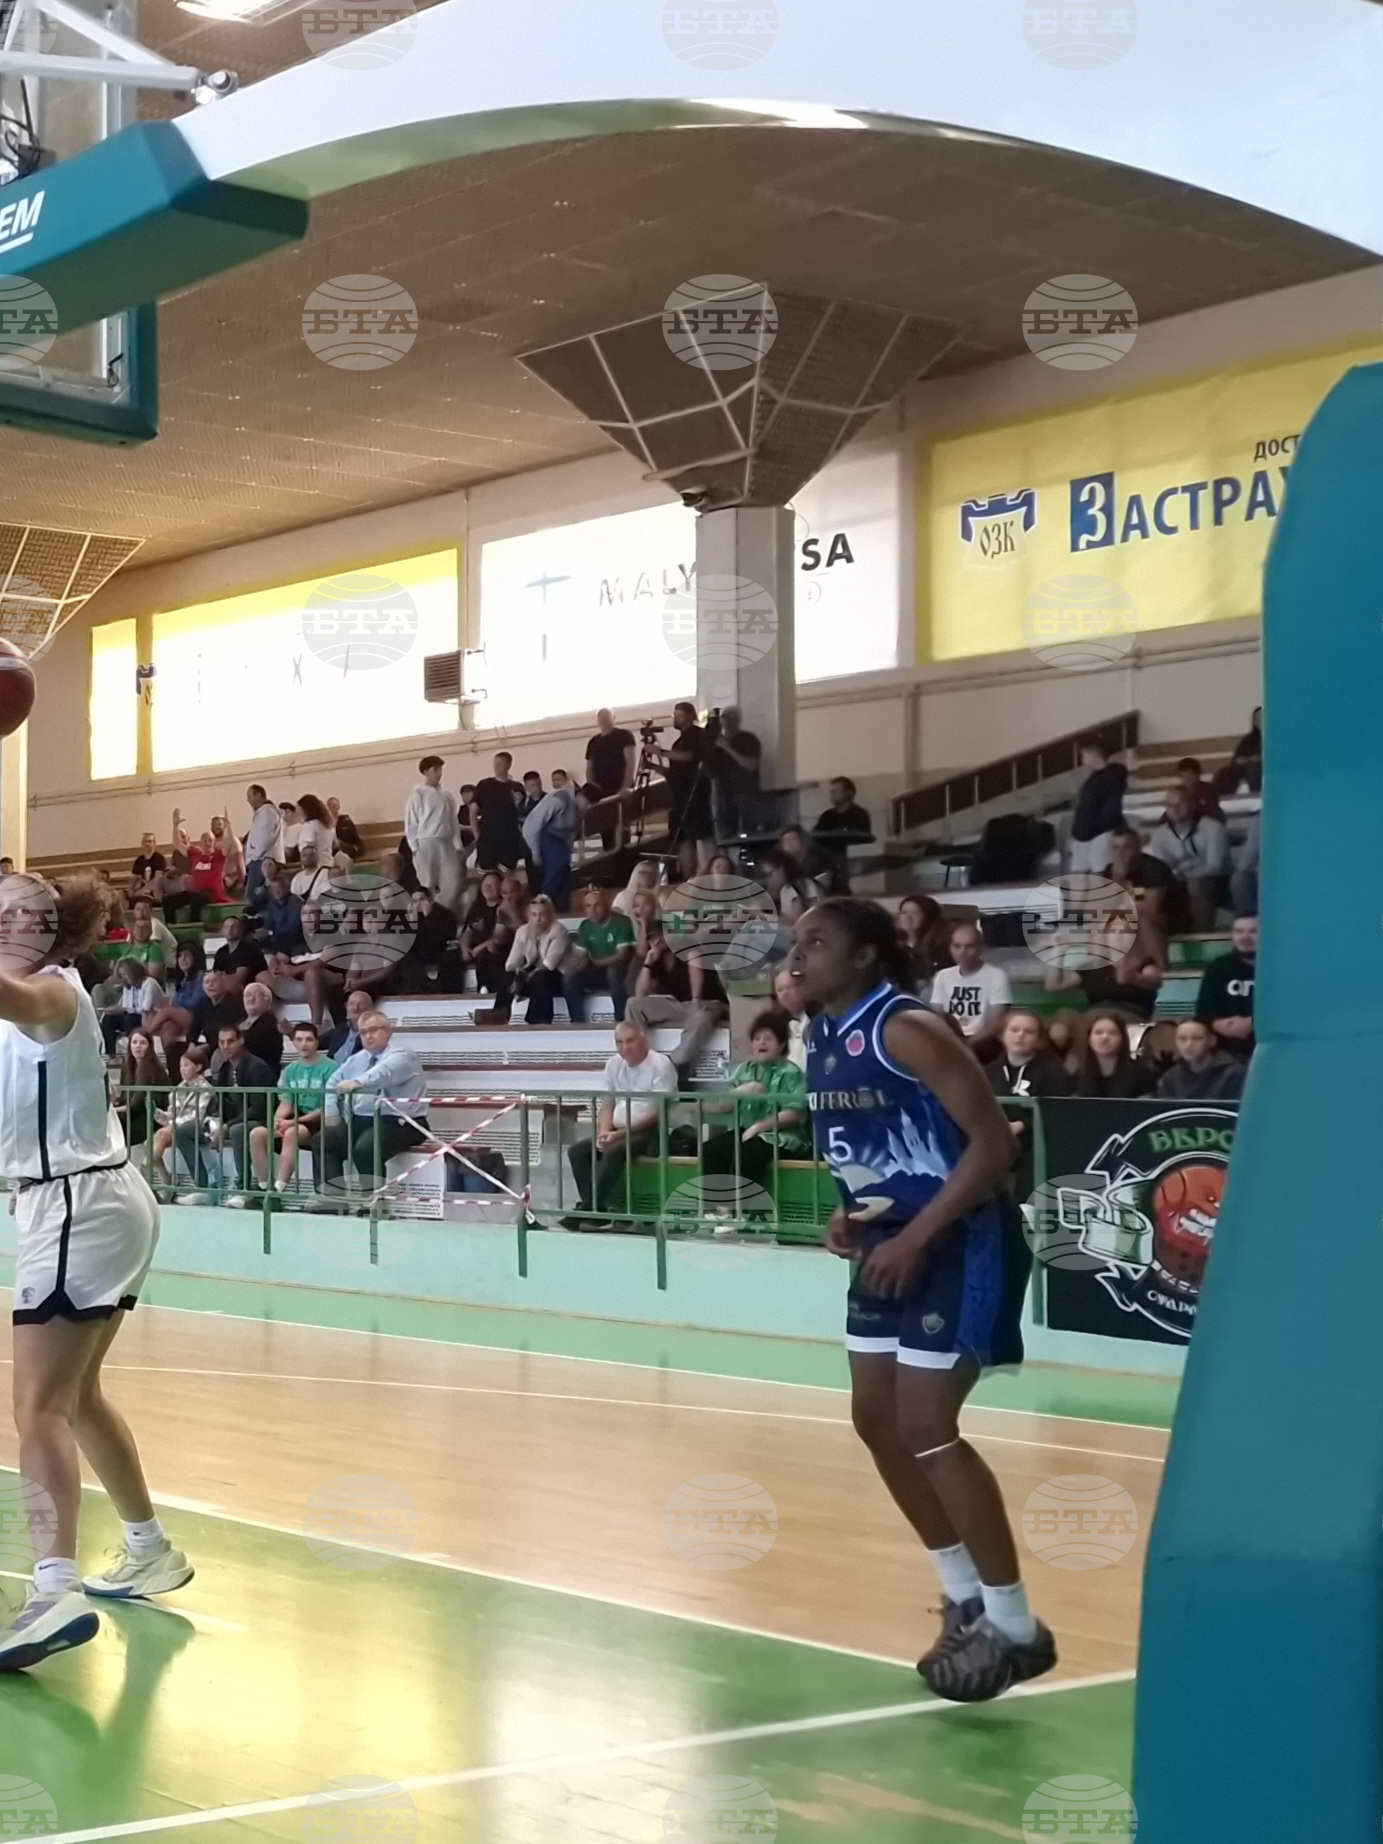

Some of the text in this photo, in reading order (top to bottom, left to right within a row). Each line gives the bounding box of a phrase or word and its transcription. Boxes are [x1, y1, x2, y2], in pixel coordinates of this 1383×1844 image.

[950, 986, 982, 1001] JUST
[949, 1001, 982, 1016] DO IT
[828, 1126, 853, 1163] 5
